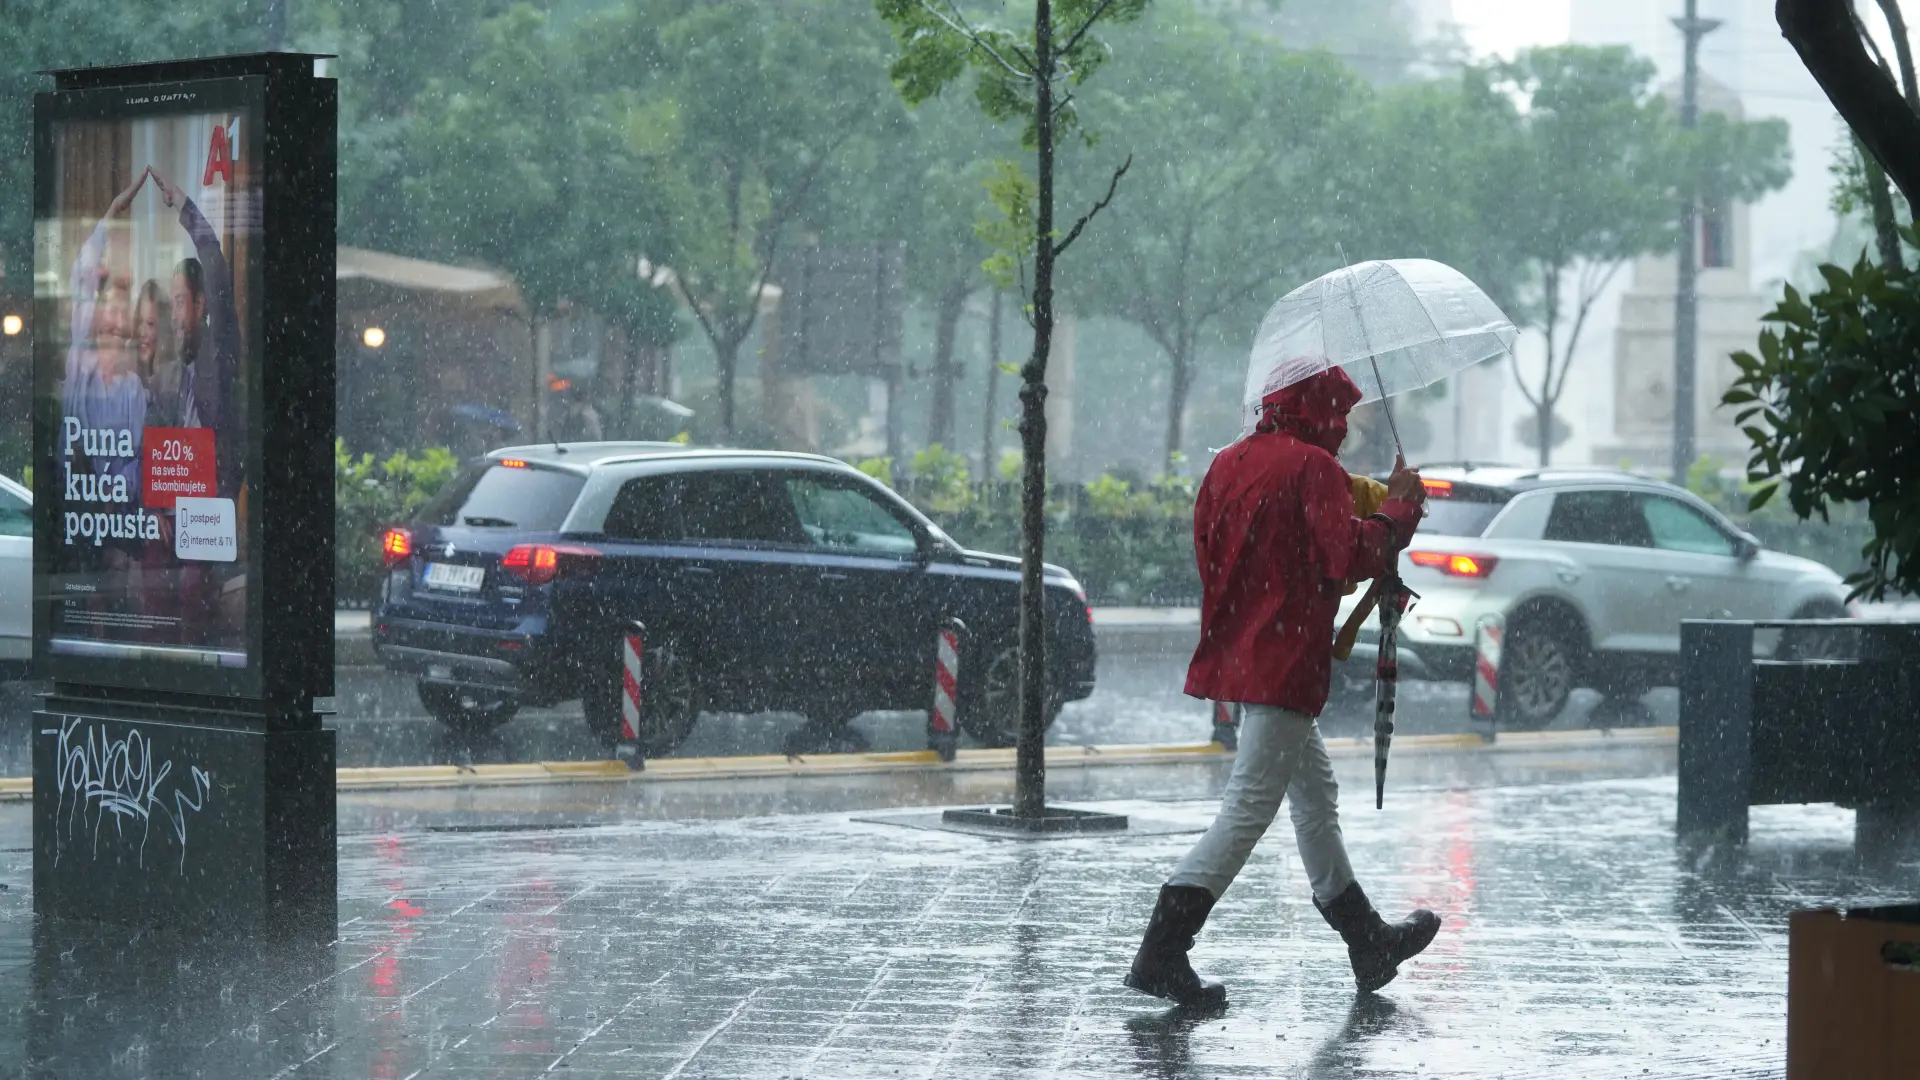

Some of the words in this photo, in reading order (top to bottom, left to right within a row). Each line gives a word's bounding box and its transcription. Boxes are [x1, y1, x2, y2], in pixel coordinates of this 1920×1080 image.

[203, 116, 241, 186] A1
[64, 416, 134, 458] Puna
[152, 448, 162, 460] Po
[151, 466, 162, 476] na
[163, 467, 177, 477] sve
[177, 464, 189, 477] što
[64, 461, 129, 503] kuća
[151, 479, 207, 495] iskombinujete
[64, 507, 161, 547] popusta
[190, 513, 221, 527] postpejd
[190, 536, 217, 546] internet
[218, 537, 225, 546] &
[225, 537, 233, 547] TV
